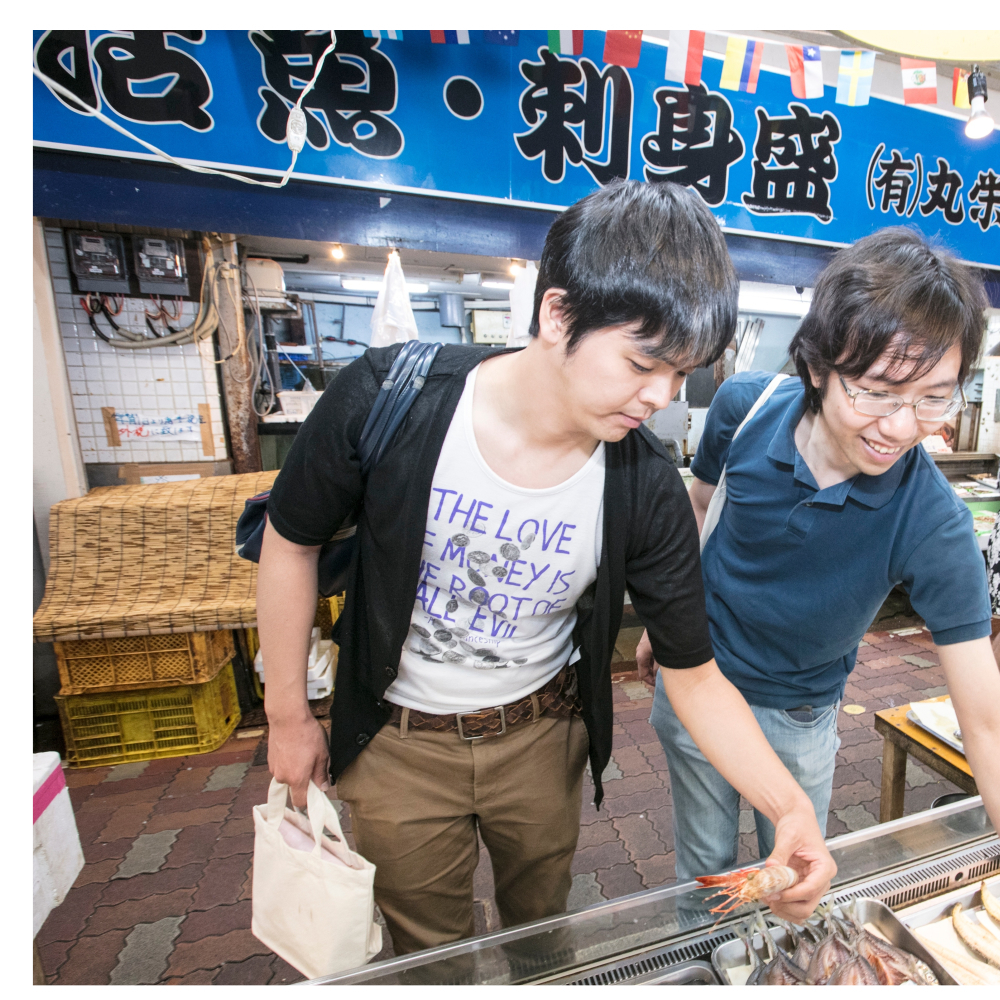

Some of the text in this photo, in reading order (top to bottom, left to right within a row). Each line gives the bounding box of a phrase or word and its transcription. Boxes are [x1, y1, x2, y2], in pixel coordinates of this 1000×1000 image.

[433, 487, 577, 555] THE LOVE
[449, 574, 533, 621] ROOT
[546, 570, 576, 596] IS
